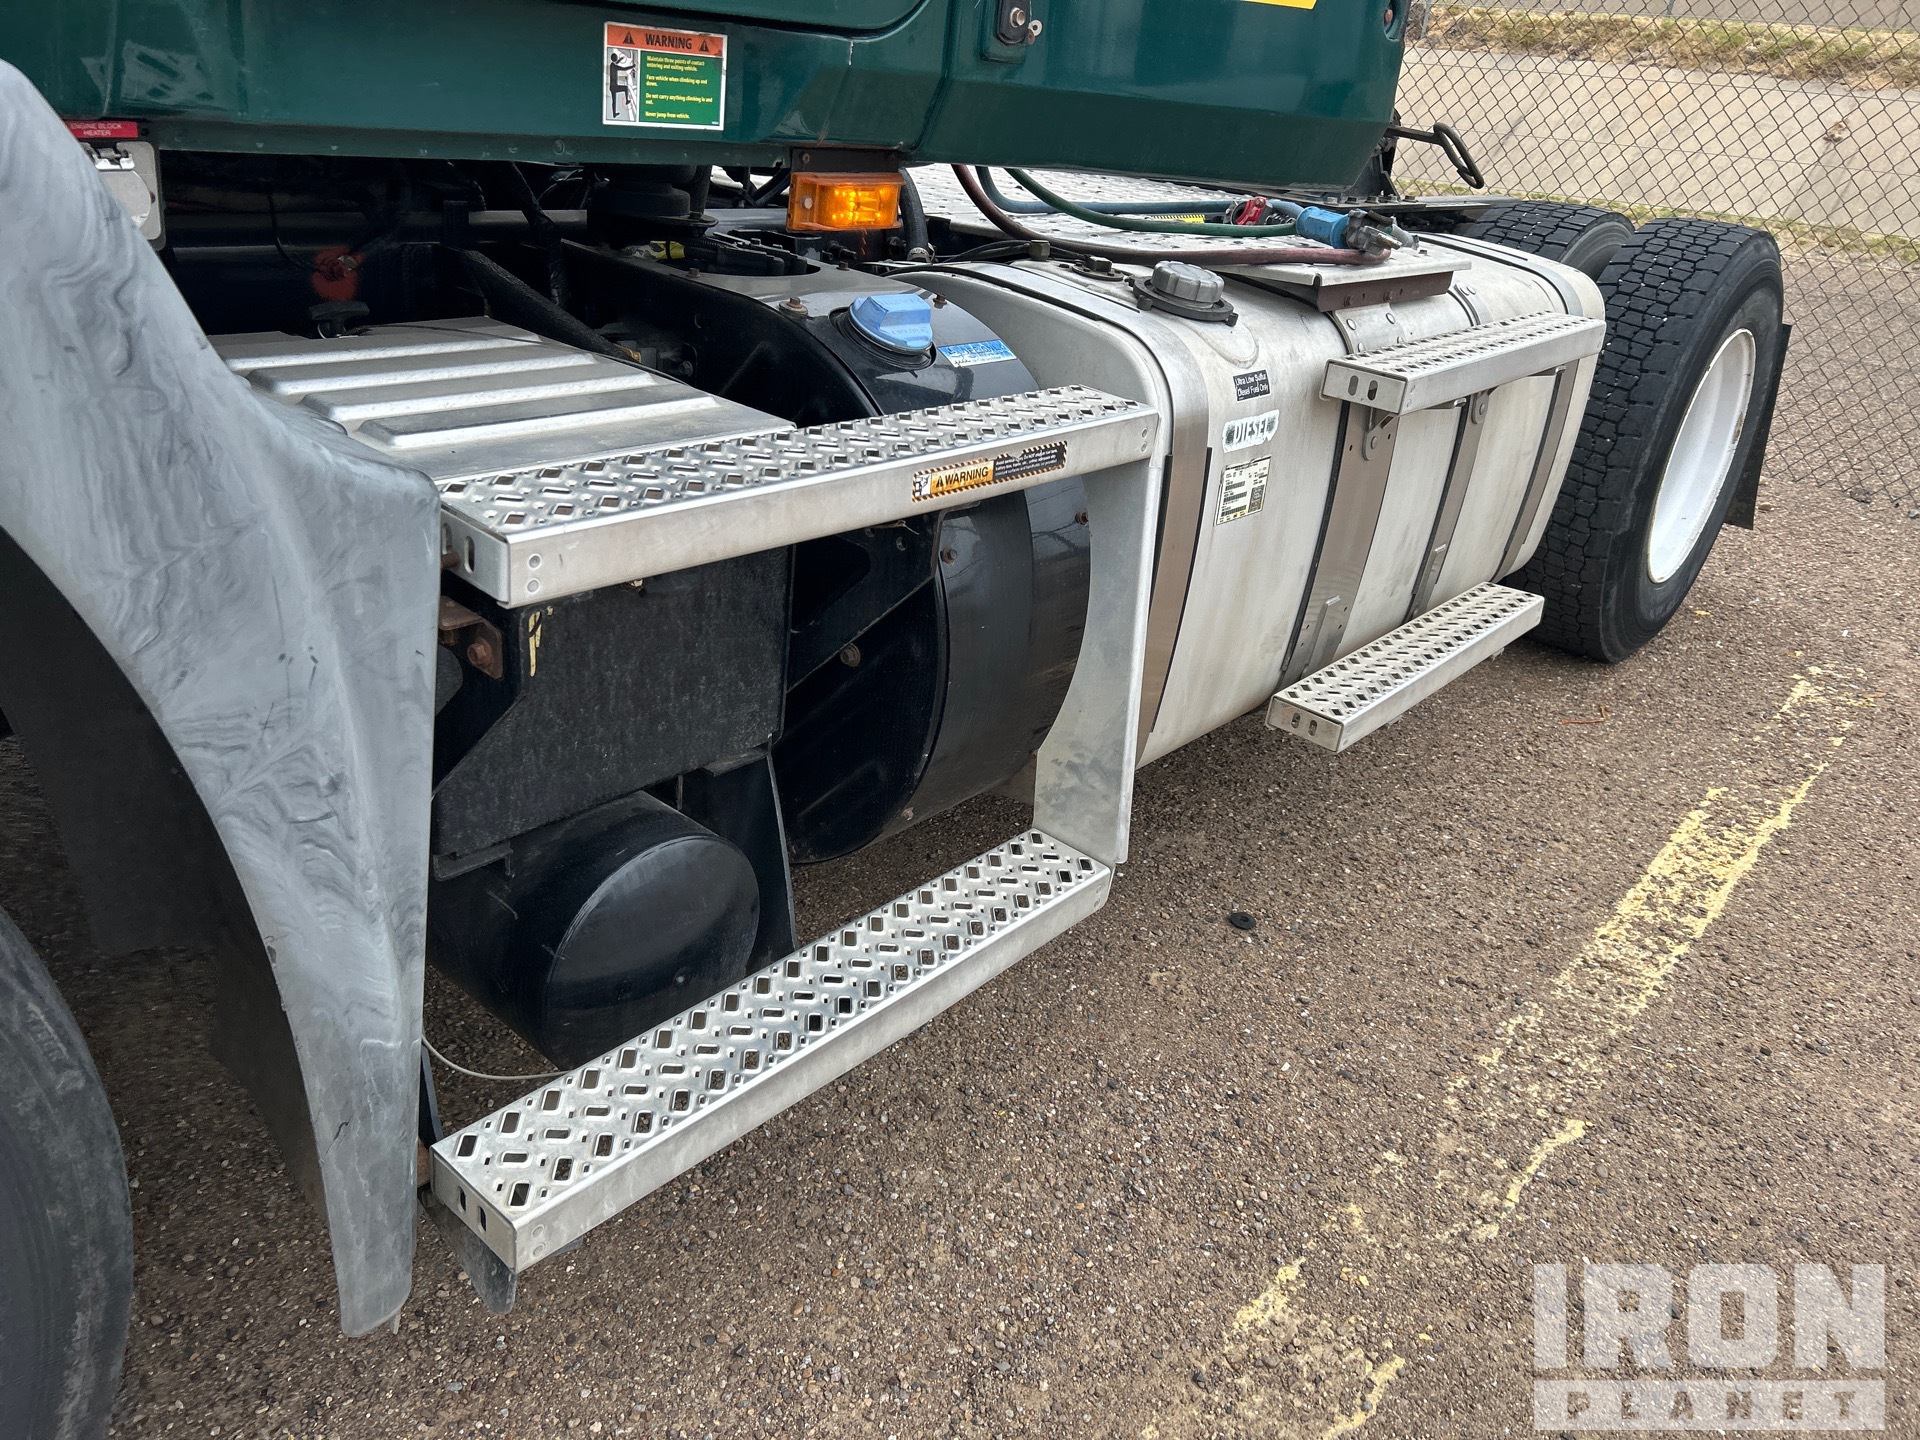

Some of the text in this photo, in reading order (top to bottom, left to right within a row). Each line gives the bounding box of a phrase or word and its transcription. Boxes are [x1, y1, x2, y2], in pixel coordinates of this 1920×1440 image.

[645, 33, 692, 50] WARNING
[680, 77, 695, 85] climbing
[83, 129, 112, 137] HEATER
[1234, 373, 1266, 386] Ultra Low Sulfur
[1237, 383, 1268, 397] Diesel Fuel Only
[1233, 417, 1269, 441] DIESEL
[944, 466, 989, 486] WARNING
